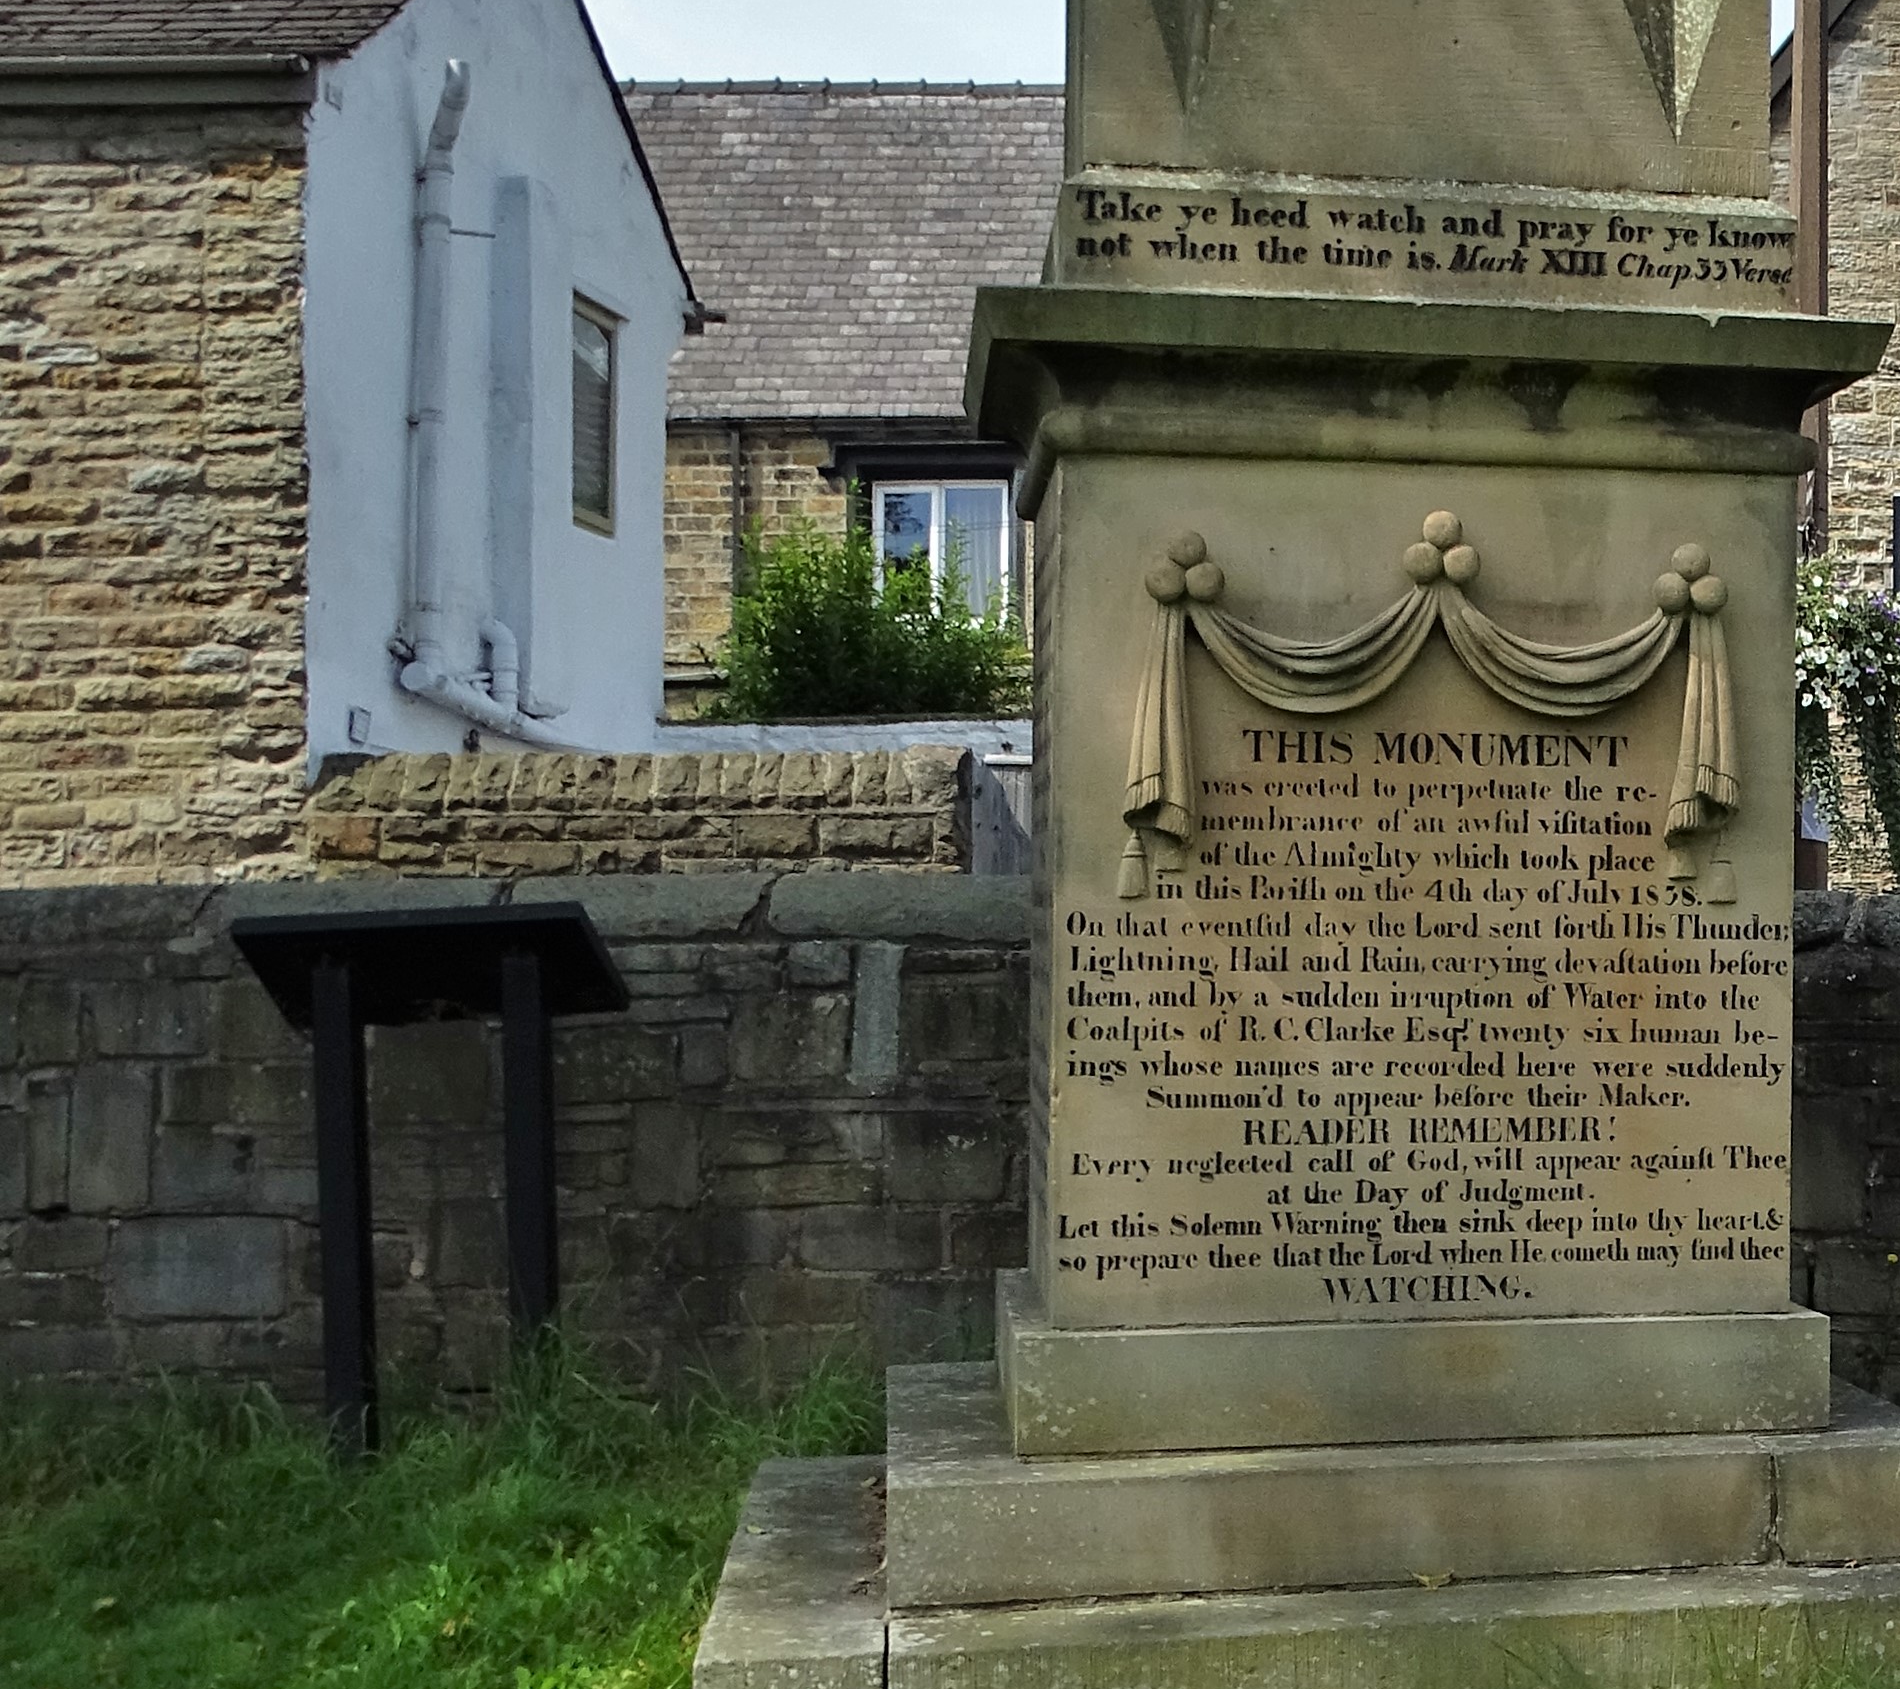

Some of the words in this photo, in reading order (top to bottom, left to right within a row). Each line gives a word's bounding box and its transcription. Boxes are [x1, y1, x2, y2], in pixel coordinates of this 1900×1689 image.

[1076, 189, 1162, 223] Take
[1174, 205, 1218, 231] ye
[1230, 197, 1310, 229] heed
[1327, 204, 1426, 233] watch
[1442, 209, 1505, 238] and
[1518, 218, 1595, 247] pray
[1606, 216, 1654, 244] for
[1663, 227, 1699, 251] ye
[1706, 220, 1796, 249] know
[1076, 232, 1132, 258] not
[1148, 232, 1240, 262] when
[1257, 236, 1308, 263] the
[1322, 239, 1393, 268] time
[1448, 244, 1529, 273] Mark
[1541, 248, 1608, 277] XIII
[1242, 730, 1354, 764] THIS
[1374, 731, 1629, 767] MONUMENT
[1201, 779, 1253, 798] was
[1264, 773, 1359, 798] erected
[1374, 777, 1397, 798] to
[1408, 778, 1552, 808] perpetuate
[1564, 776, 1603, 801] the
[1201, 841, 1229, 866] of
[1234, 842, 1276, 867] the
[1284, 841, 1420, 878] Almighty
[1433, 842, 1510, 870] which
[1520, 844, 1580, 871] took
[1588, 844, 1655, 880] place
[1066, 1050, 1128, 1086] ings
[1140, 1051, 1223, 1077] whose
[1233, 1060, 1319, 1078] names
[1332, 1060, 1374, 1077] are
[1384, 1051, 1504, 1078] recorded
[1517, 1051, 1576, 1077] here
[1592, 1060, 1653, 1077] were
[1665, 1053, 1785, 1086] suddenly
[1297, 1088, 1320, 1109] to
[1333, 1093, 1423, 1116] appear
[1434, 1083, 1514, 1108] before
[1527, 1084, 1587, 1108] their
[1598, 1084, 1691, 1108] Maker.
[1243, 1117, 1390, 1146] READER
[1408, 1115, 1617, 1144] REMEMBER!
[1267, 1181, 1291, 1205] at
[1303, 1180, 1343, 1205] the
[1354, 1179, 1409, 1211] Day
[1421, 1179, 1449, 1204] of
[1459, 1179, 1596, 1210] Judgment.
[1058, 1256, 1087, 1272] so
[1096, 1253, 1199, 1281] prepare
[1208, 1243, 1262, 1269] thee
[1272, 1243, 1322, 1268] that
[1328, 1242, 1366, 1267] the
[1371, 1240, 1432, 1266] Lord
[1440, 1239, 1503, 1265] when
[1510, 1238, 1547, 1264] He
[1550, 1237, 1630, 1263] cometh
[1636, 1244, 1684, 1267] may
[1690, 1237, 1735, 1261] find
[1739, 1236, 1785, 1261] thee
[1322, 1275, 1536, 1305] WATCHING.
